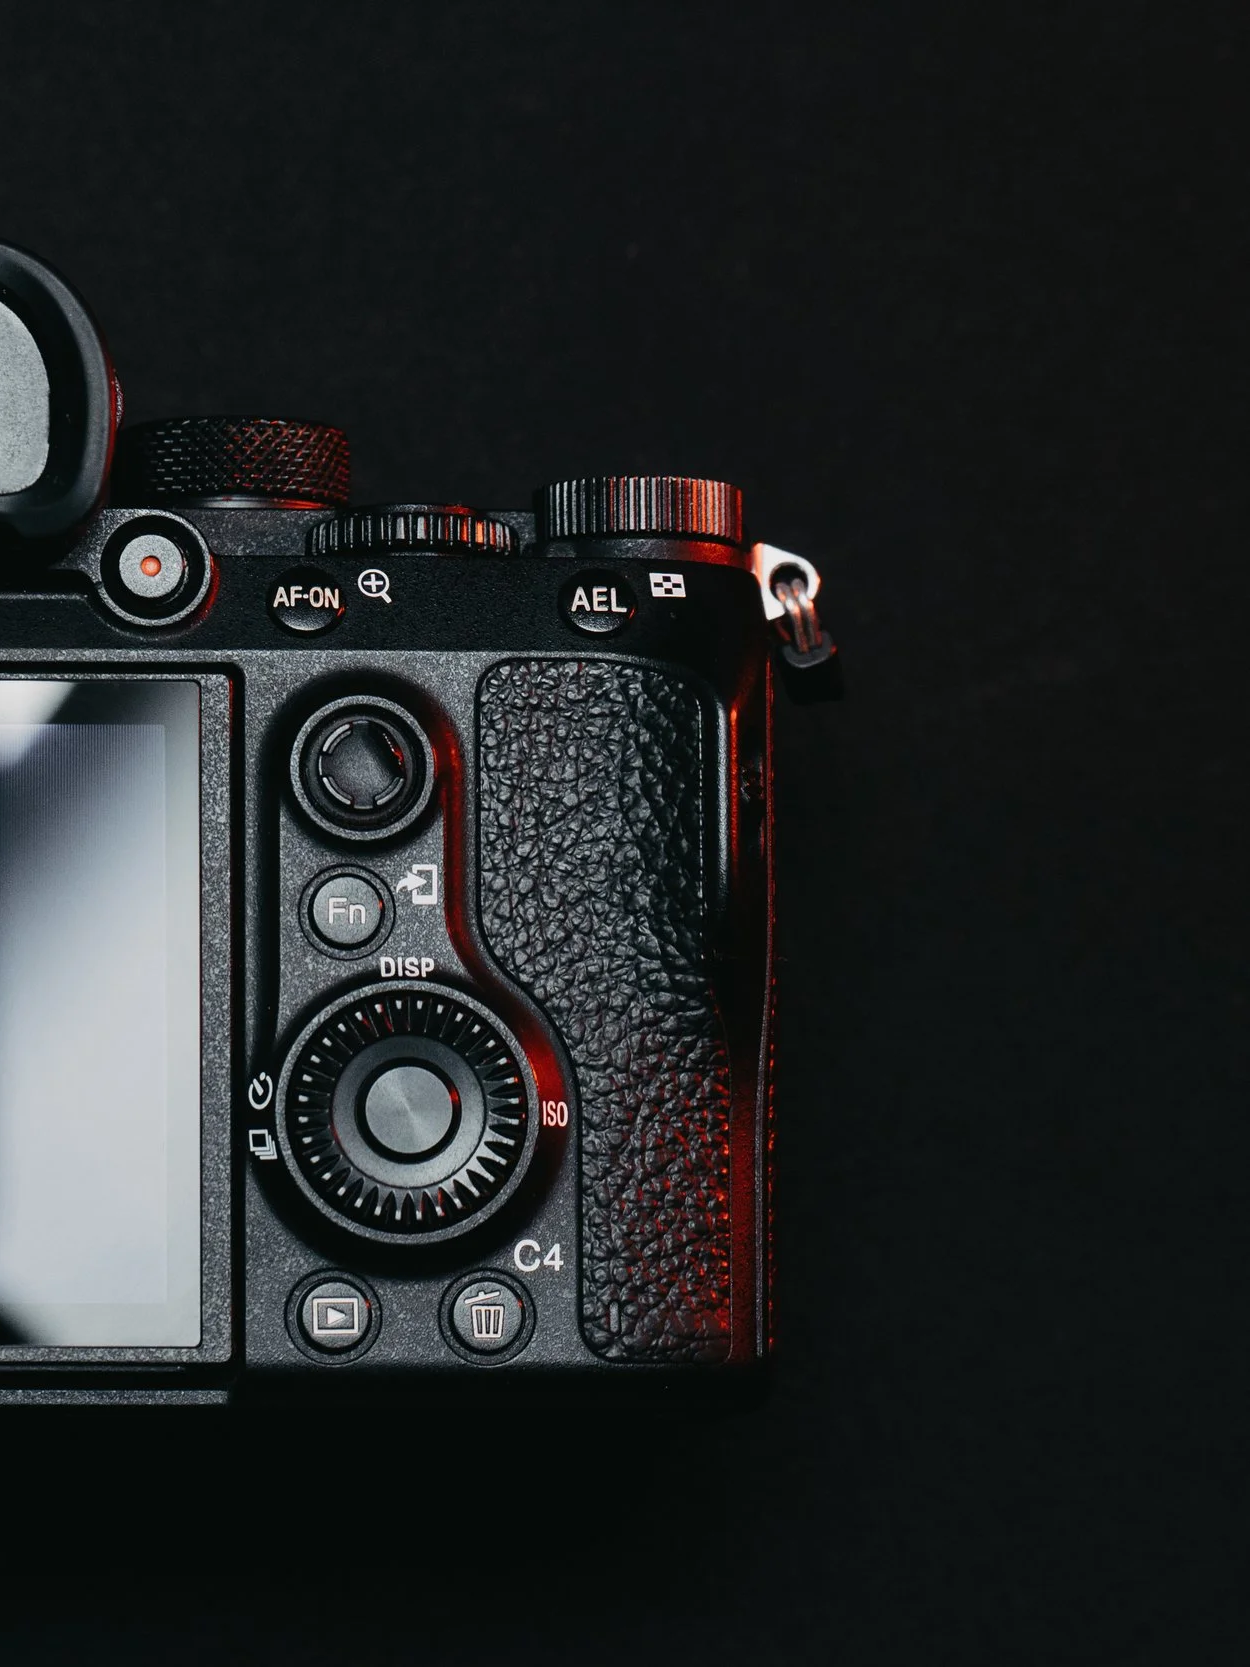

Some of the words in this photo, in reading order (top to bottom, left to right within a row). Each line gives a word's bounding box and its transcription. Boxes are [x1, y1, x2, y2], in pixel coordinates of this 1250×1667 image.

[571, 586, 628, 613] AEL
[328, 896, 366, 924] Fn
[380, 956, 435, 978] DISP
[542, 1100, 569, 1127] ISO
[513, 1239, 564, 1272] C4
